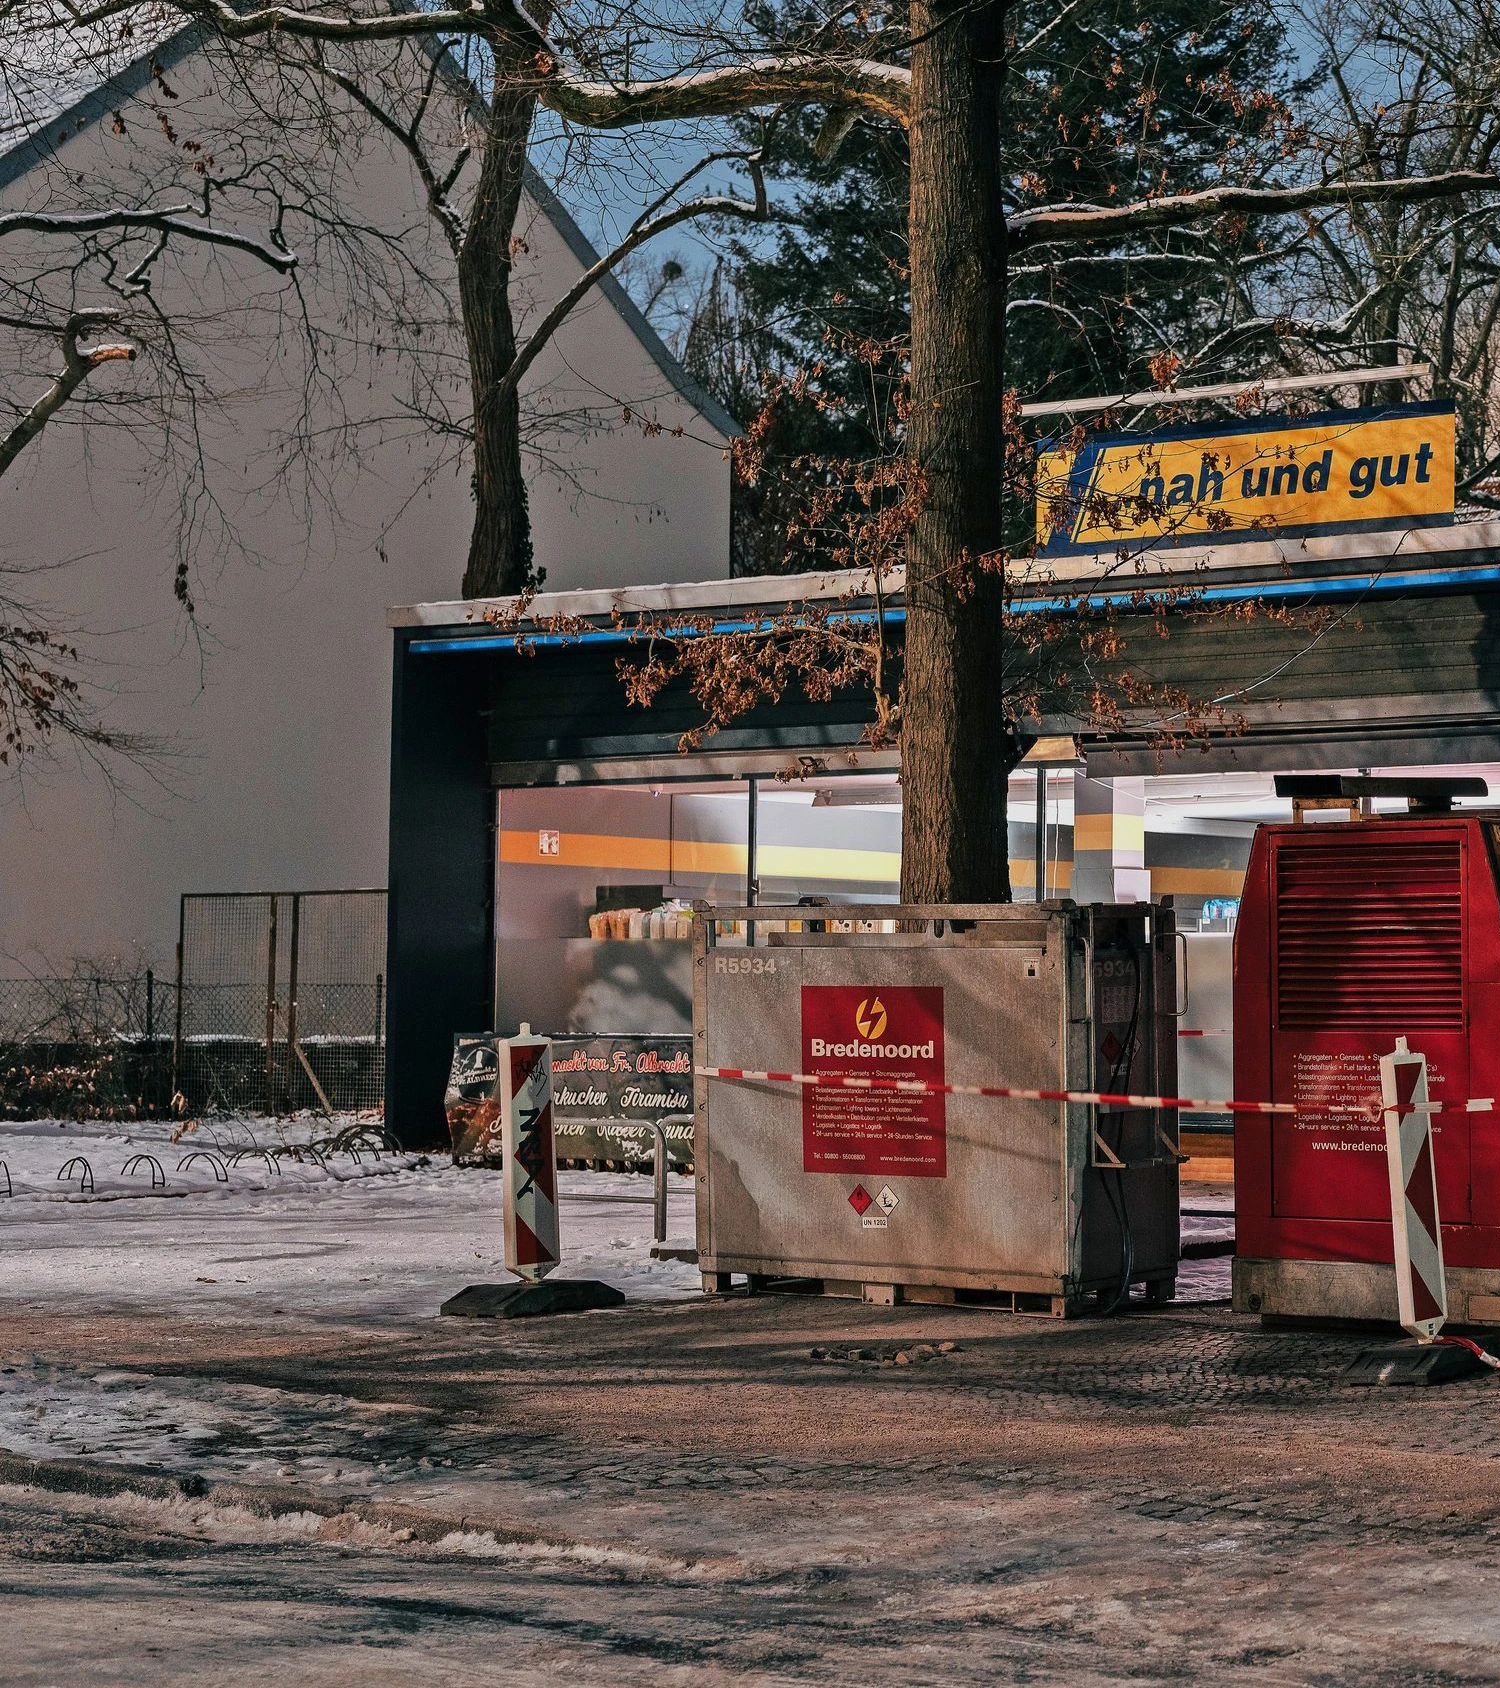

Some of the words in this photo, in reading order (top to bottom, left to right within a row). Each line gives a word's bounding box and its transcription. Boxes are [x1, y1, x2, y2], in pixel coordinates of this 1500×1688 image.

[1139, 453, 1225, 507] nah
[1241, 450, 1333, 498] und
[1349, 442, 1435, 498] gut
[715, 957, 777, 974] R5934
[811, 1038, 935, 1059] Bredenoord
[610, 1051, 633, 1073] Fr.
[1298, 1053, 1333, 1062] Aggregaten
[1339, 1053, 1365, 1061] Gensets
[815, 1069, 844, 1077] Aggregaten
[848, 1069, 870, 1077] Gensets
[1298, 1083, 1341, 1091] Transformatoren
[620, 1086, 690, 1109] Tiramisu
[1335, 1094, 1357, 1102] Lighting
[1298, 1113, 1323, 1121] Logistiek
[1328, 1113, 1353, 1122] Logistics
[1360, 1124, 1381, 1132] service
[915, 1133, 933, 1141] Service
[879, 1155, 937, 1163] www.bredenoord.com
